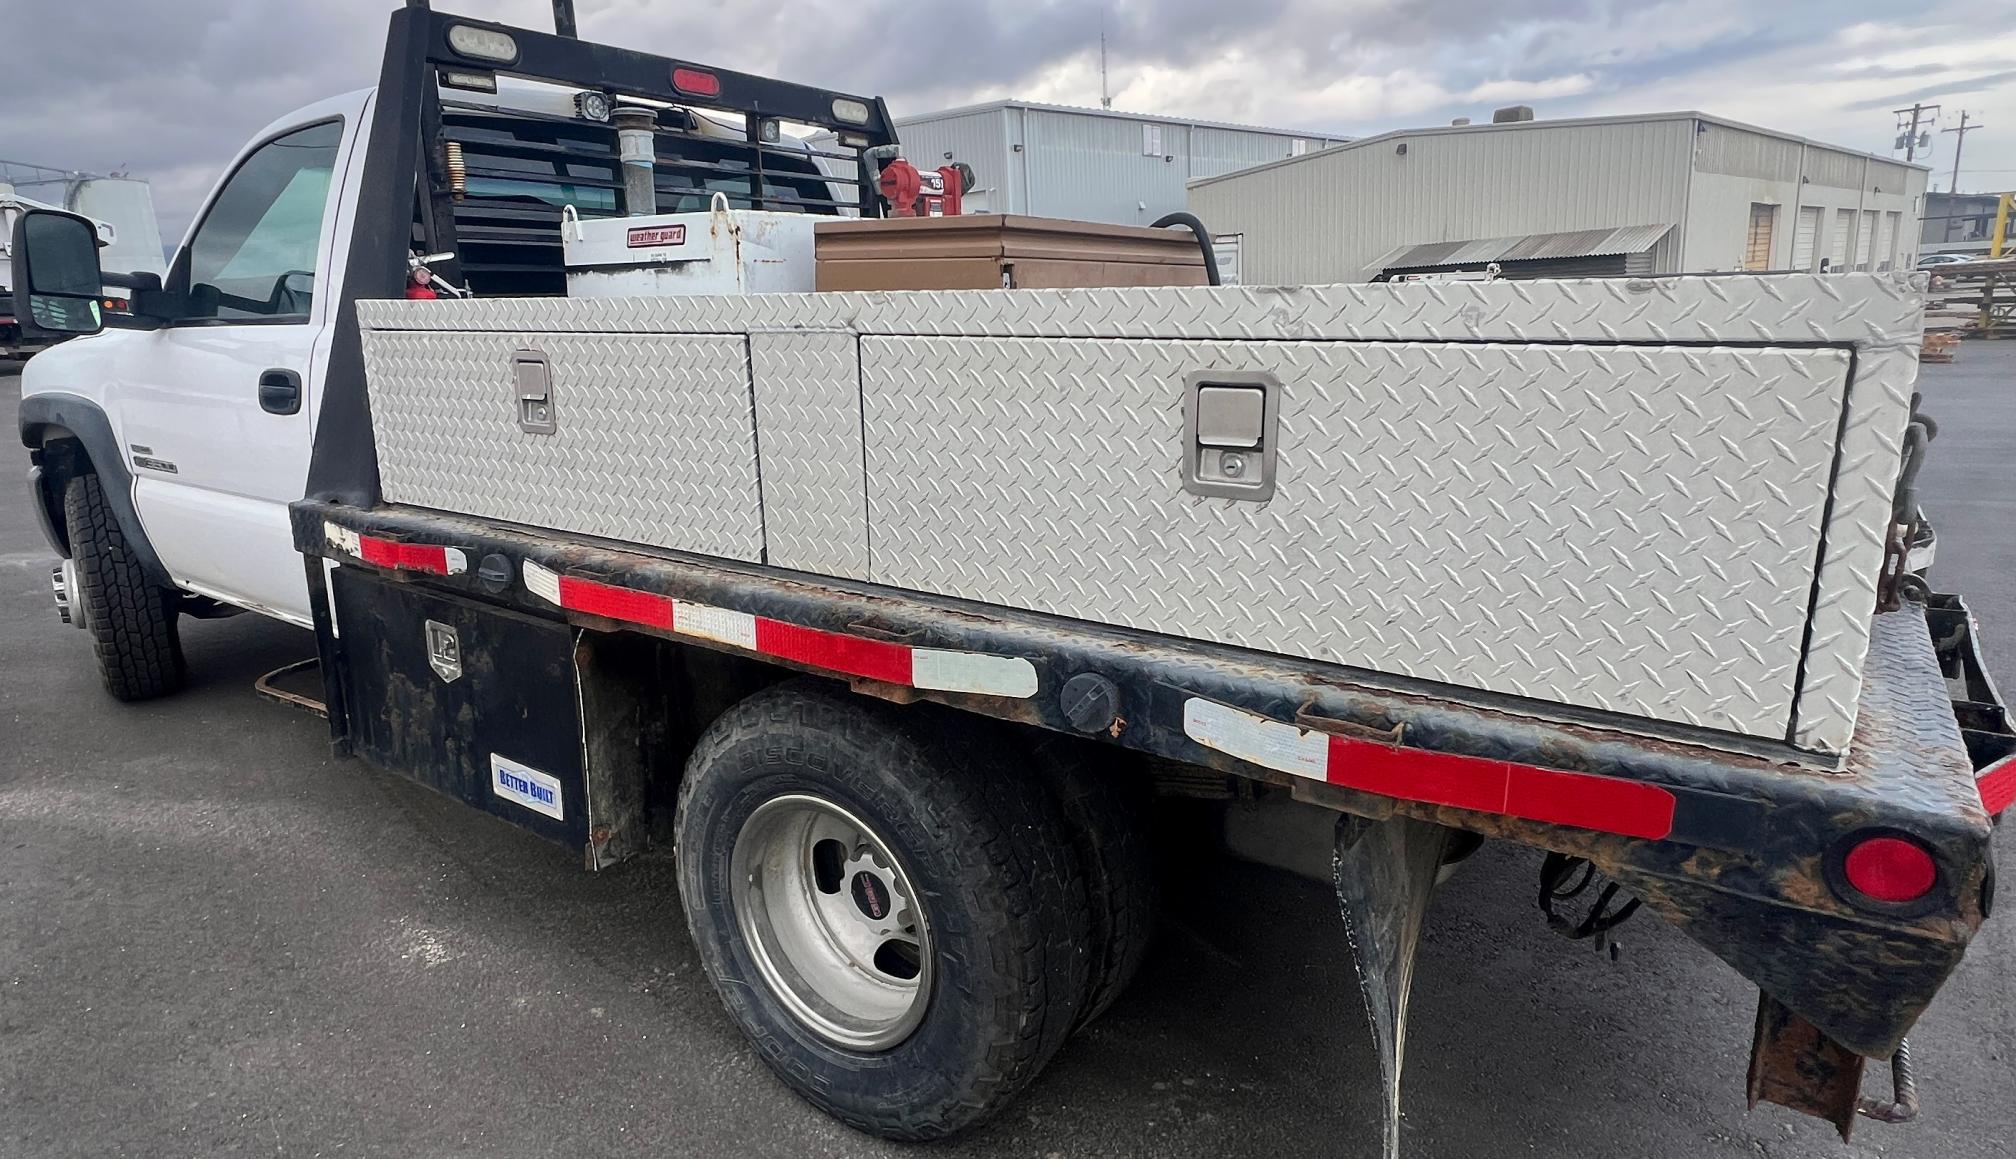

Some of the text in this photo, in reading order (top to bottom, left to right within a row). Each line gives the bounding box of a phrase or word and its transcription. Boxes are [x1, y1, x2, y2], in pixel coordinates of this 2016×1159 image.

[630, 228, 682, 243] weather guard
[499, 769, 554, 804] BETTER BUILT
[860, 873, 882, 917] GMC
